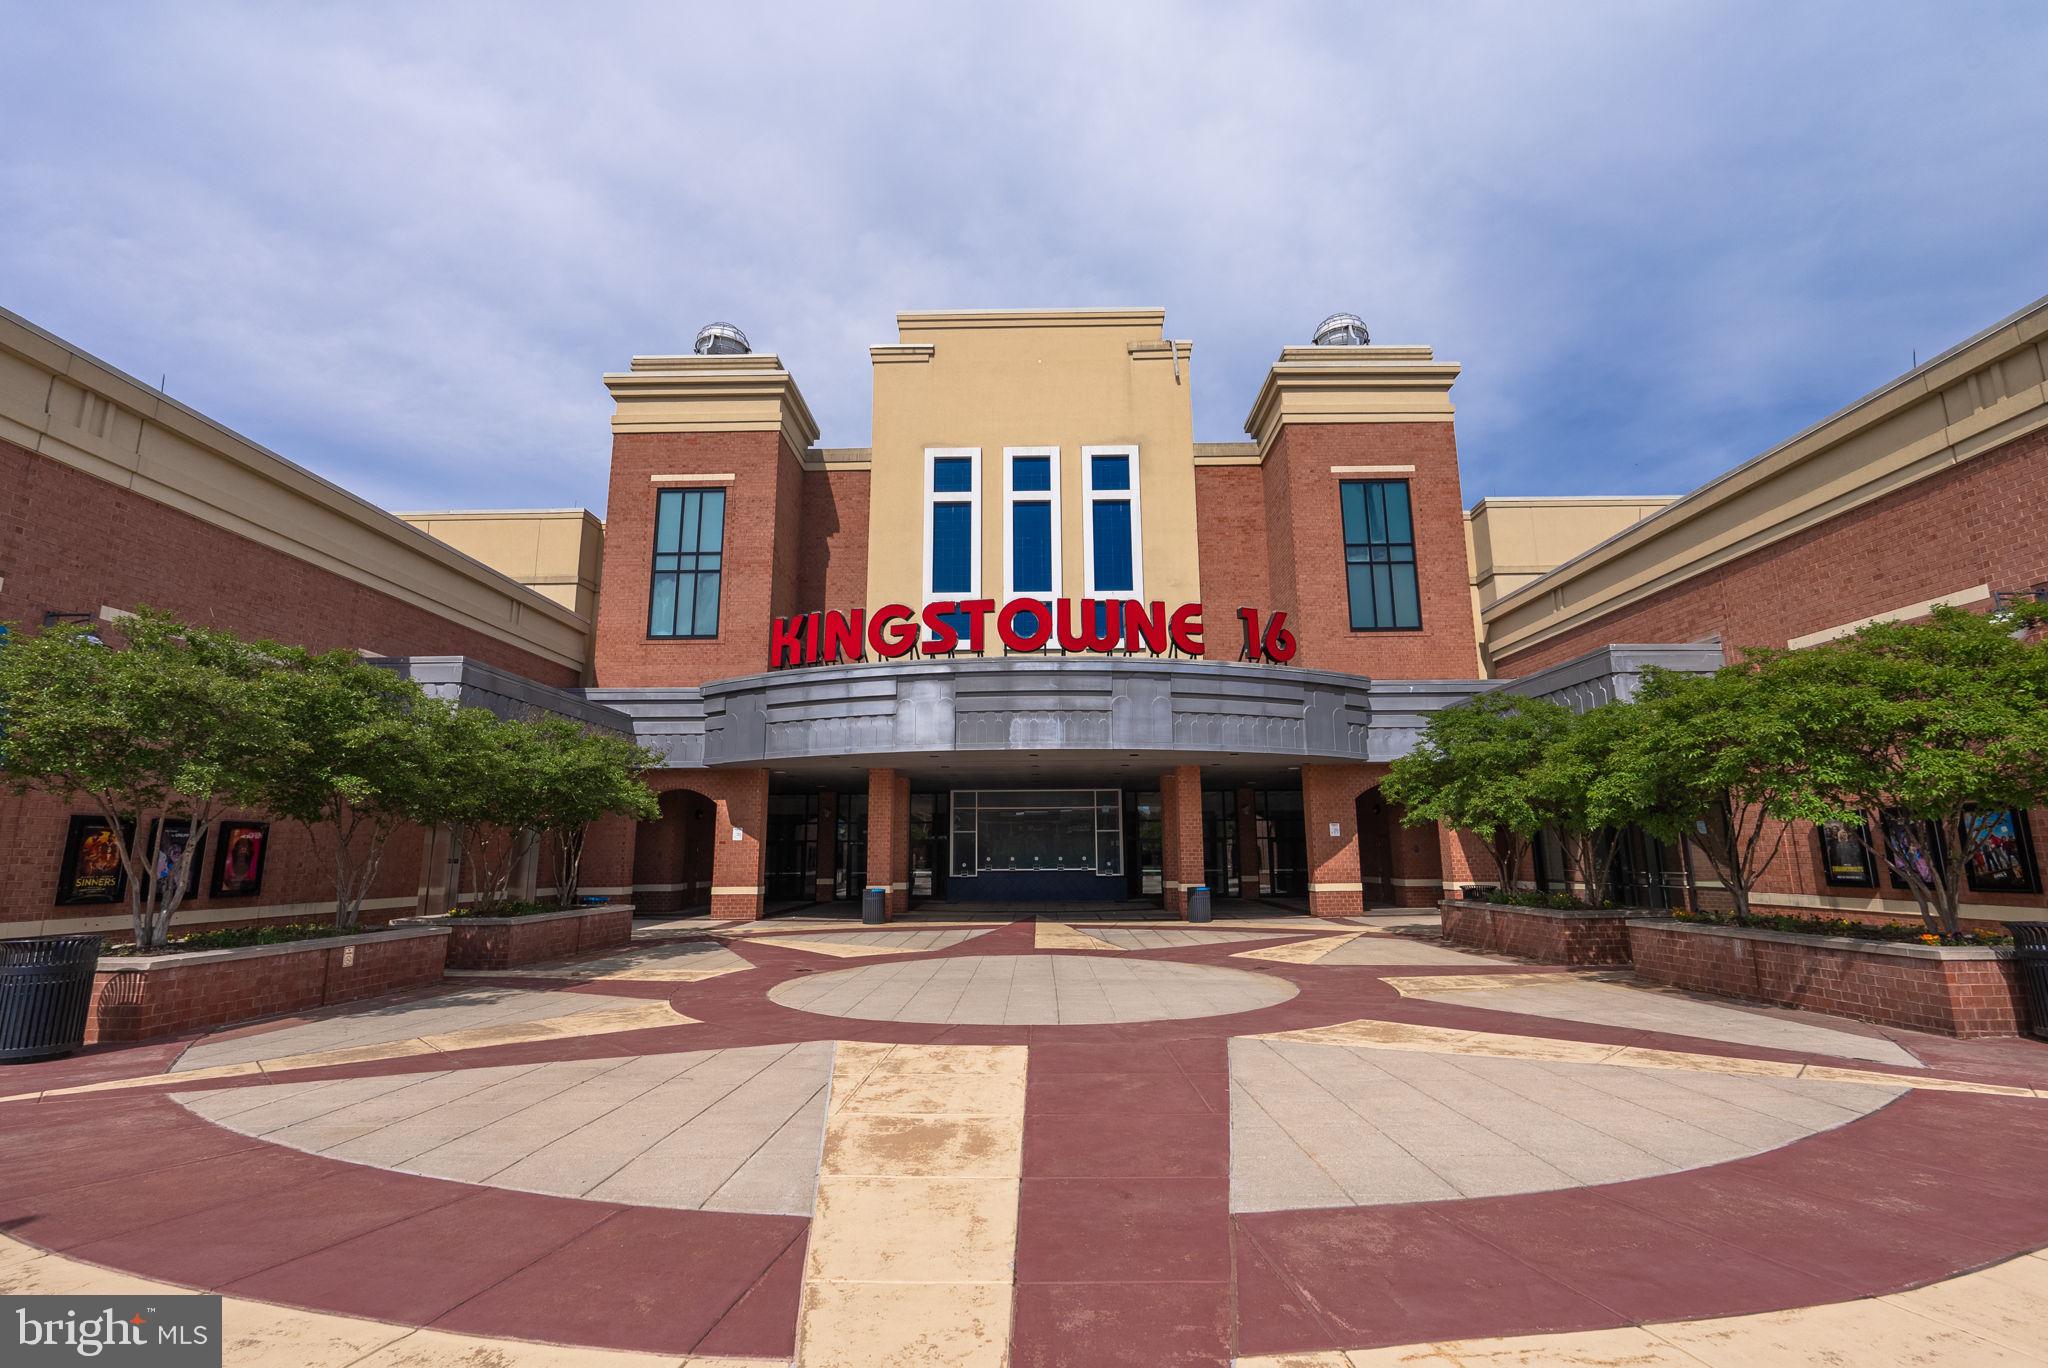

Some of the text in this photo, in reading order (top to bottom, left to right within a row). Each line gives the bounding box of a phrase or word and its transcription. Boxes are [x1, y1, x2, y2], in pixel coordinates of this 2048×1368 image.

[771, 597, 1297, 669] KINGSTOWNE 16
[75, 877, 117, 888] SINNERS
